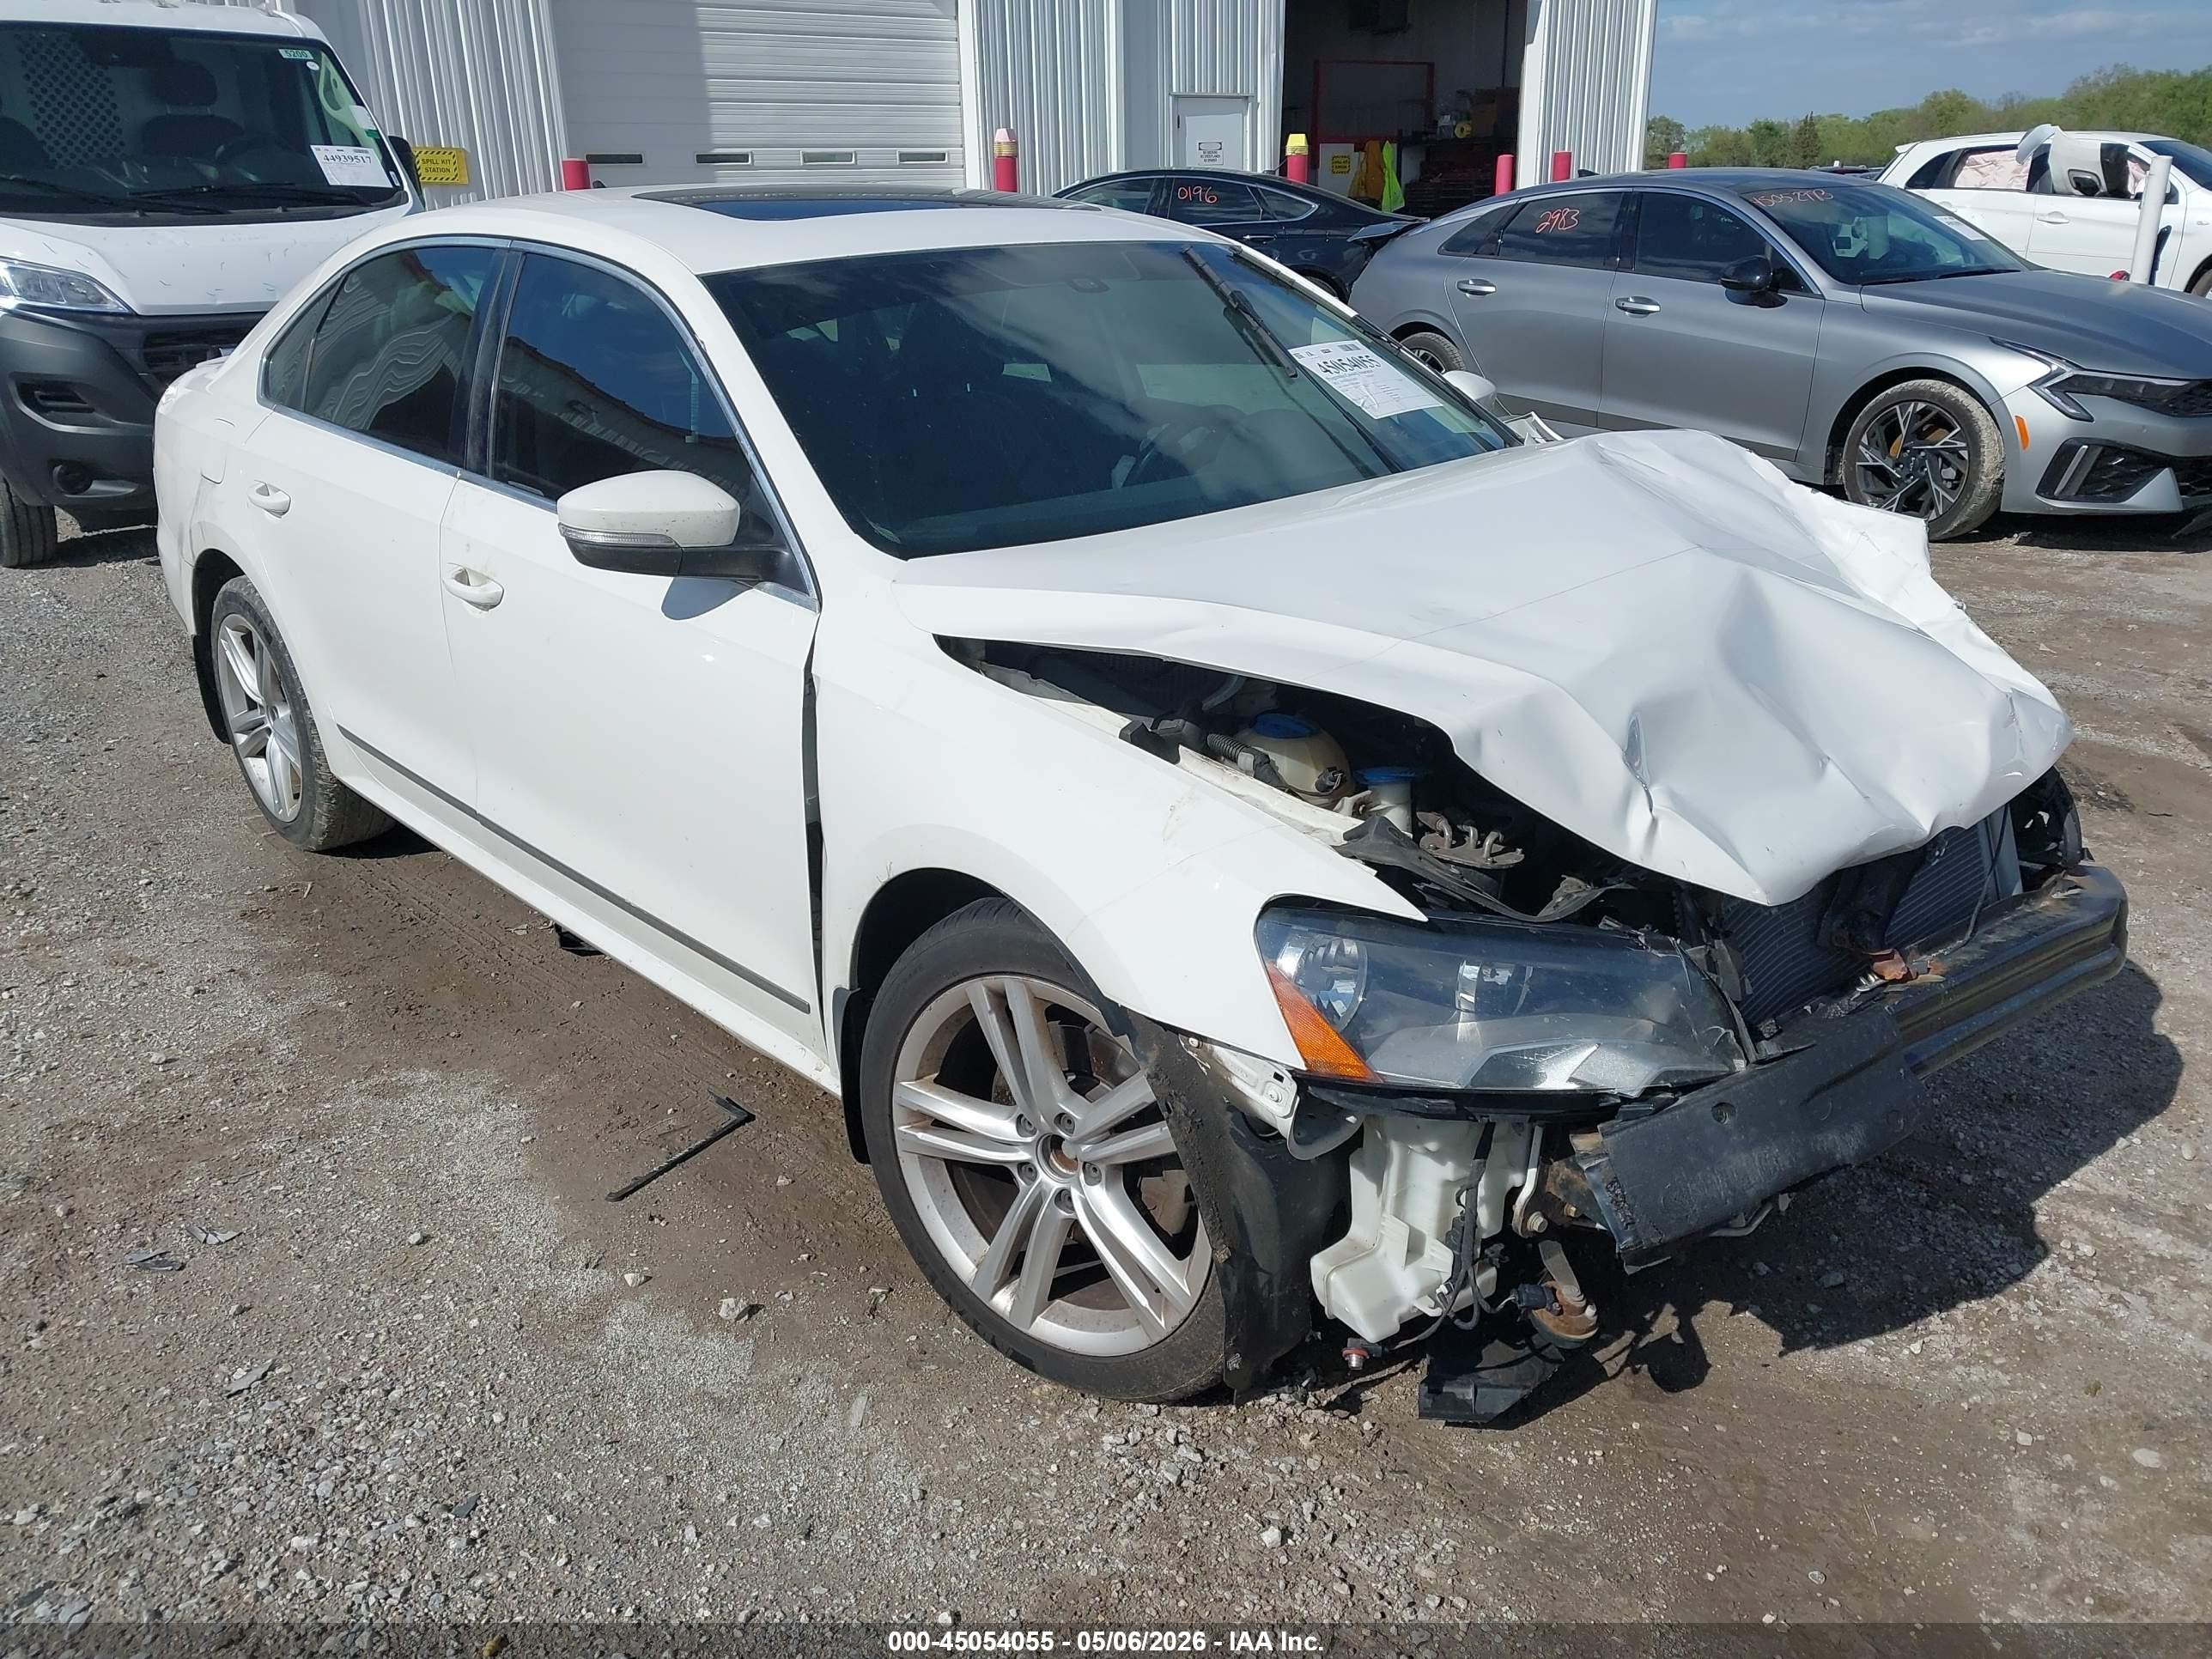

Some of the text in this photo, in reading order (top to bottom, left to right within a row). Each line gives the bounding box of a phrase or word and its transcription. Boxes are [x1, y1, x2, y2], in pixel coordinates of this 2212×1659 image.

[323, 155, 372, 164] 44939517
[1177, 185, 1218, 204] 0196
[1535, 208, 1580, 234] 2983
[1316, 355, 1381, 375] 45054055
